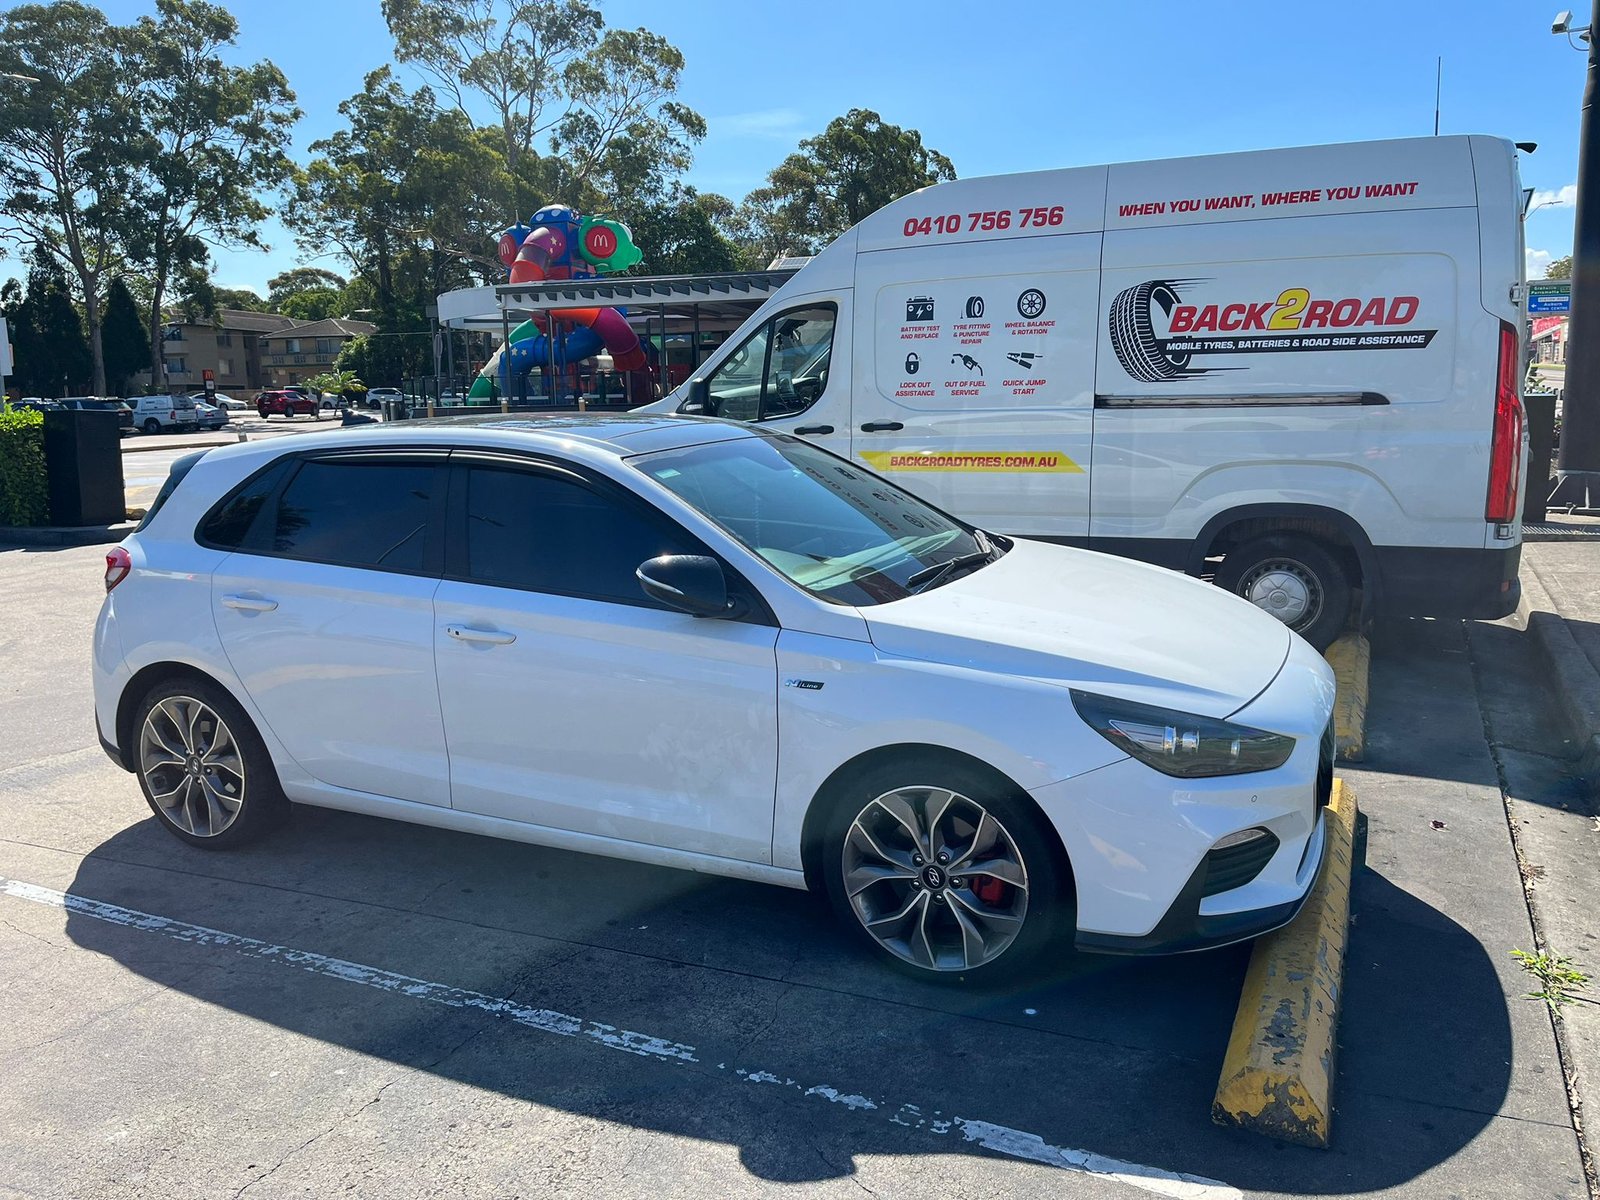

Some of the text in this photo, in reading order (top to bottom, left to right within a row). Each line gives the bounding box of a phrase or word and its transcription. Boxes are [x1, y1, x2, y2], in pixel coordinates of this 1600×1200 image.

[1119, 182, 1419, 217] WHEN YOU WANT, WHERE YOU WANT
[904, 206, 1064, 236] 0410 756 756
[1168, 287, 1420, 333] BACK2ROAD
[959, 330, 990, 338] PUNCTURE
[1166, 335, 1426, 351] MOBILE TYRES, BATTERIES & ROAD SIDE ASSISTANCE
[890, 456, 1058, 468] BACK2ROADTYRES.COM.AU
